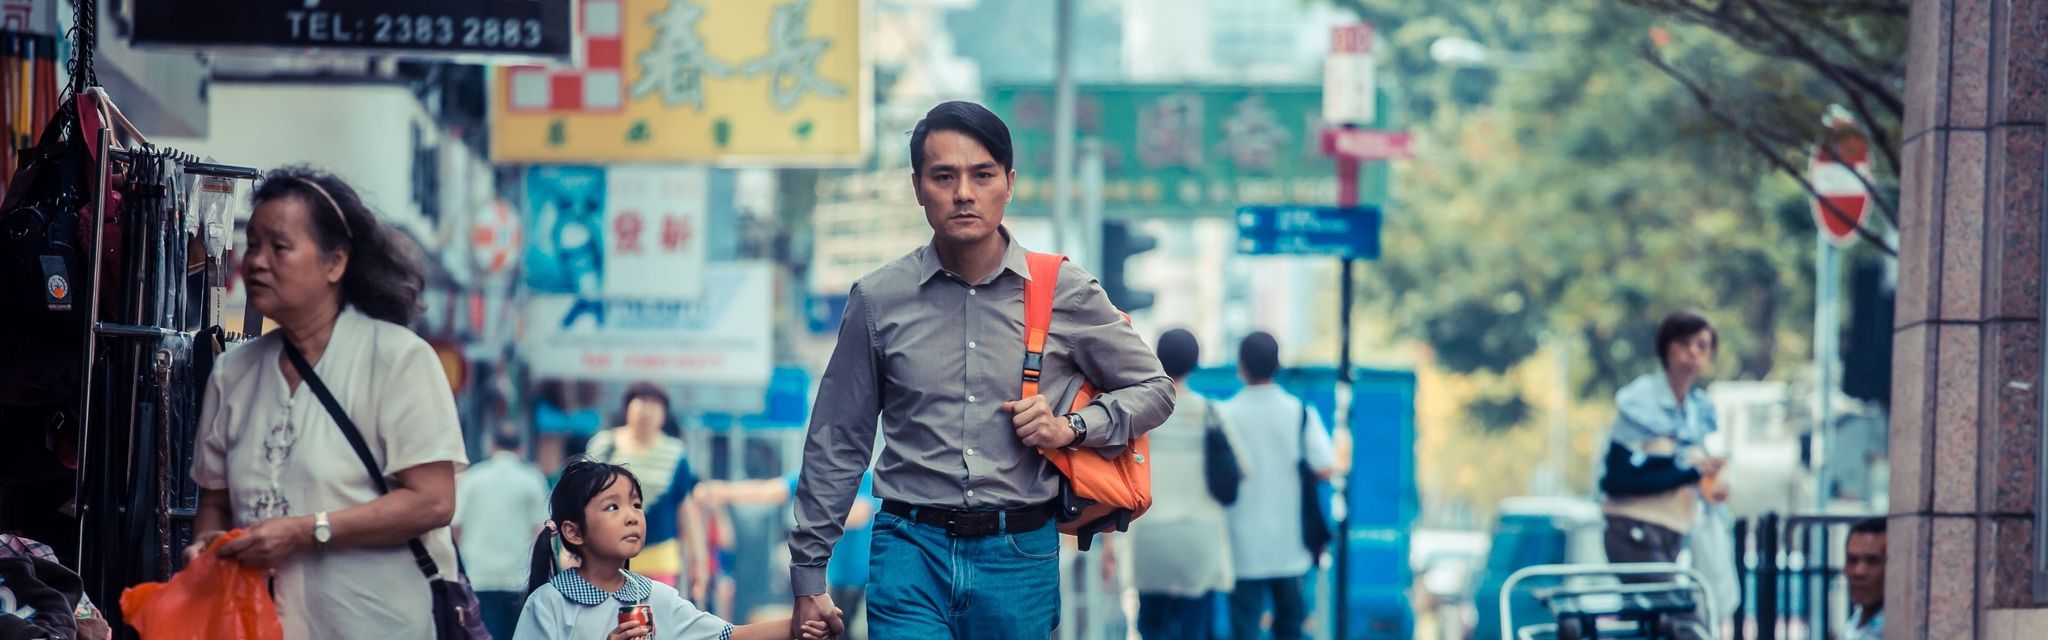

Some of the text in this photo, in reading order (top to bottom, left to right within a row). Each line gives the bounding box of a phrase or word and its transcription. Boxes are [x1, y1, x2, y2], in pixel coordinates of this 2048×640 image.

[287, 11, 542, 48] TEL: 2383 2883
